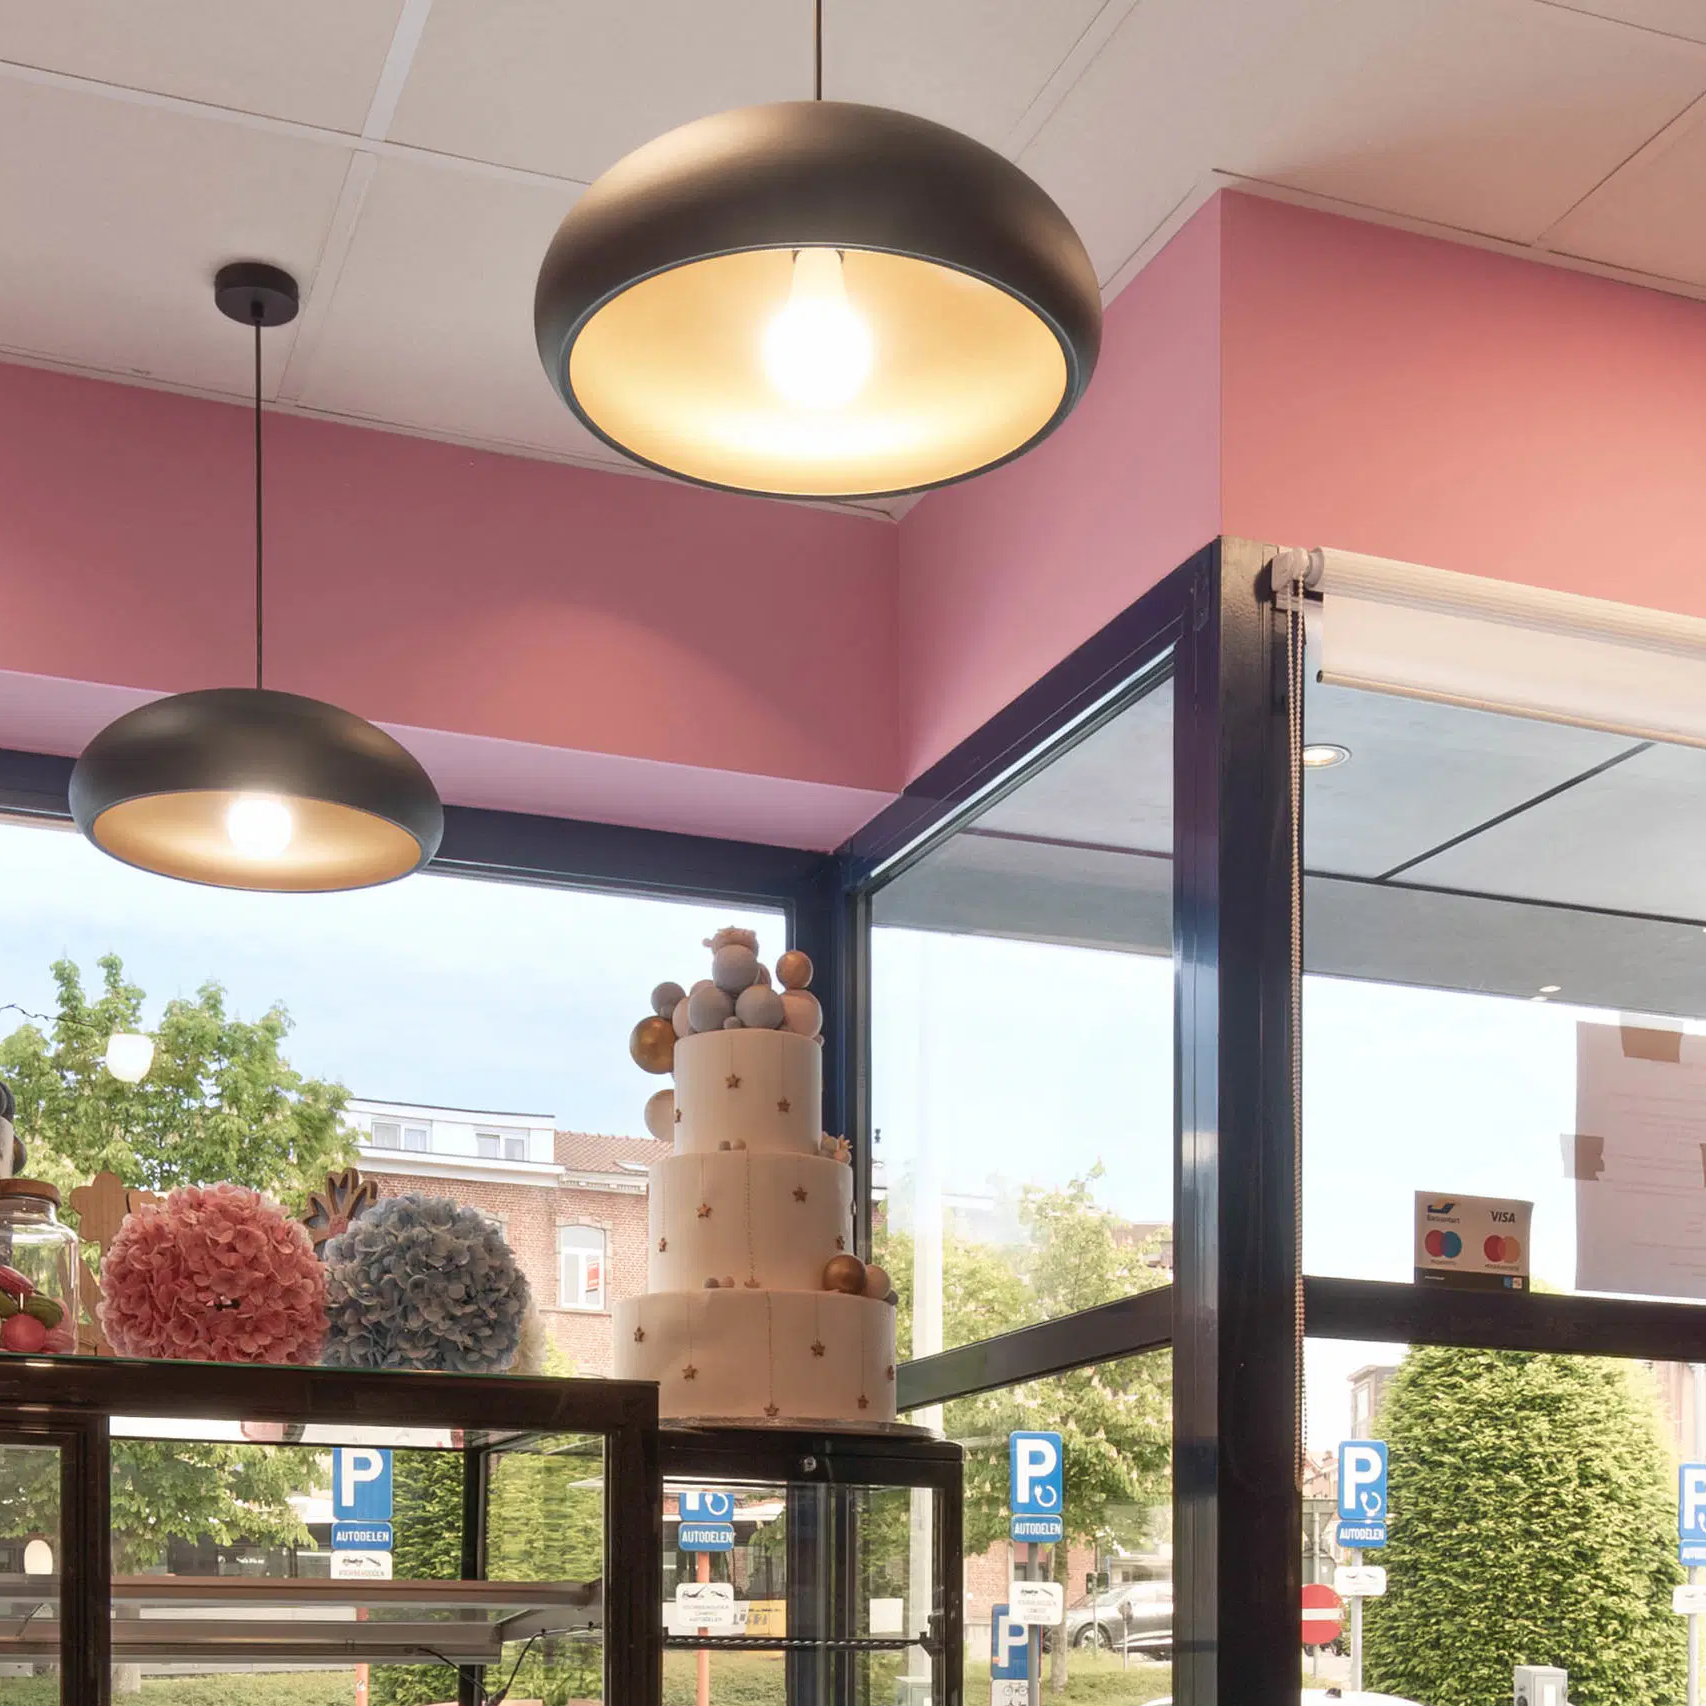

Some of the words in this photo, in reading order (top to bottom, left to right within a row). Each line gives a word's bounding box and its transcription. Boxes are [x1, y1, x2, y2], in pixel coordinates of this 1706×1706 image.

[1491, 1211, 1516, 1223] VISA
[341, 1447, 384, 1507] P
[1016, 1439, 1057, 1504] P
[1344, 1446, 1382, 1509] P
[336, 1530, 389, 1542] AUTODELEN
[1014, 1522, 1061, 1536] AUTODELEN
[1339, 1527, 1384, 1541] AUTODELEN
[682, 1530, 733, 1544] AUTODELEN
[998, 1615, 1029, 1668] P
